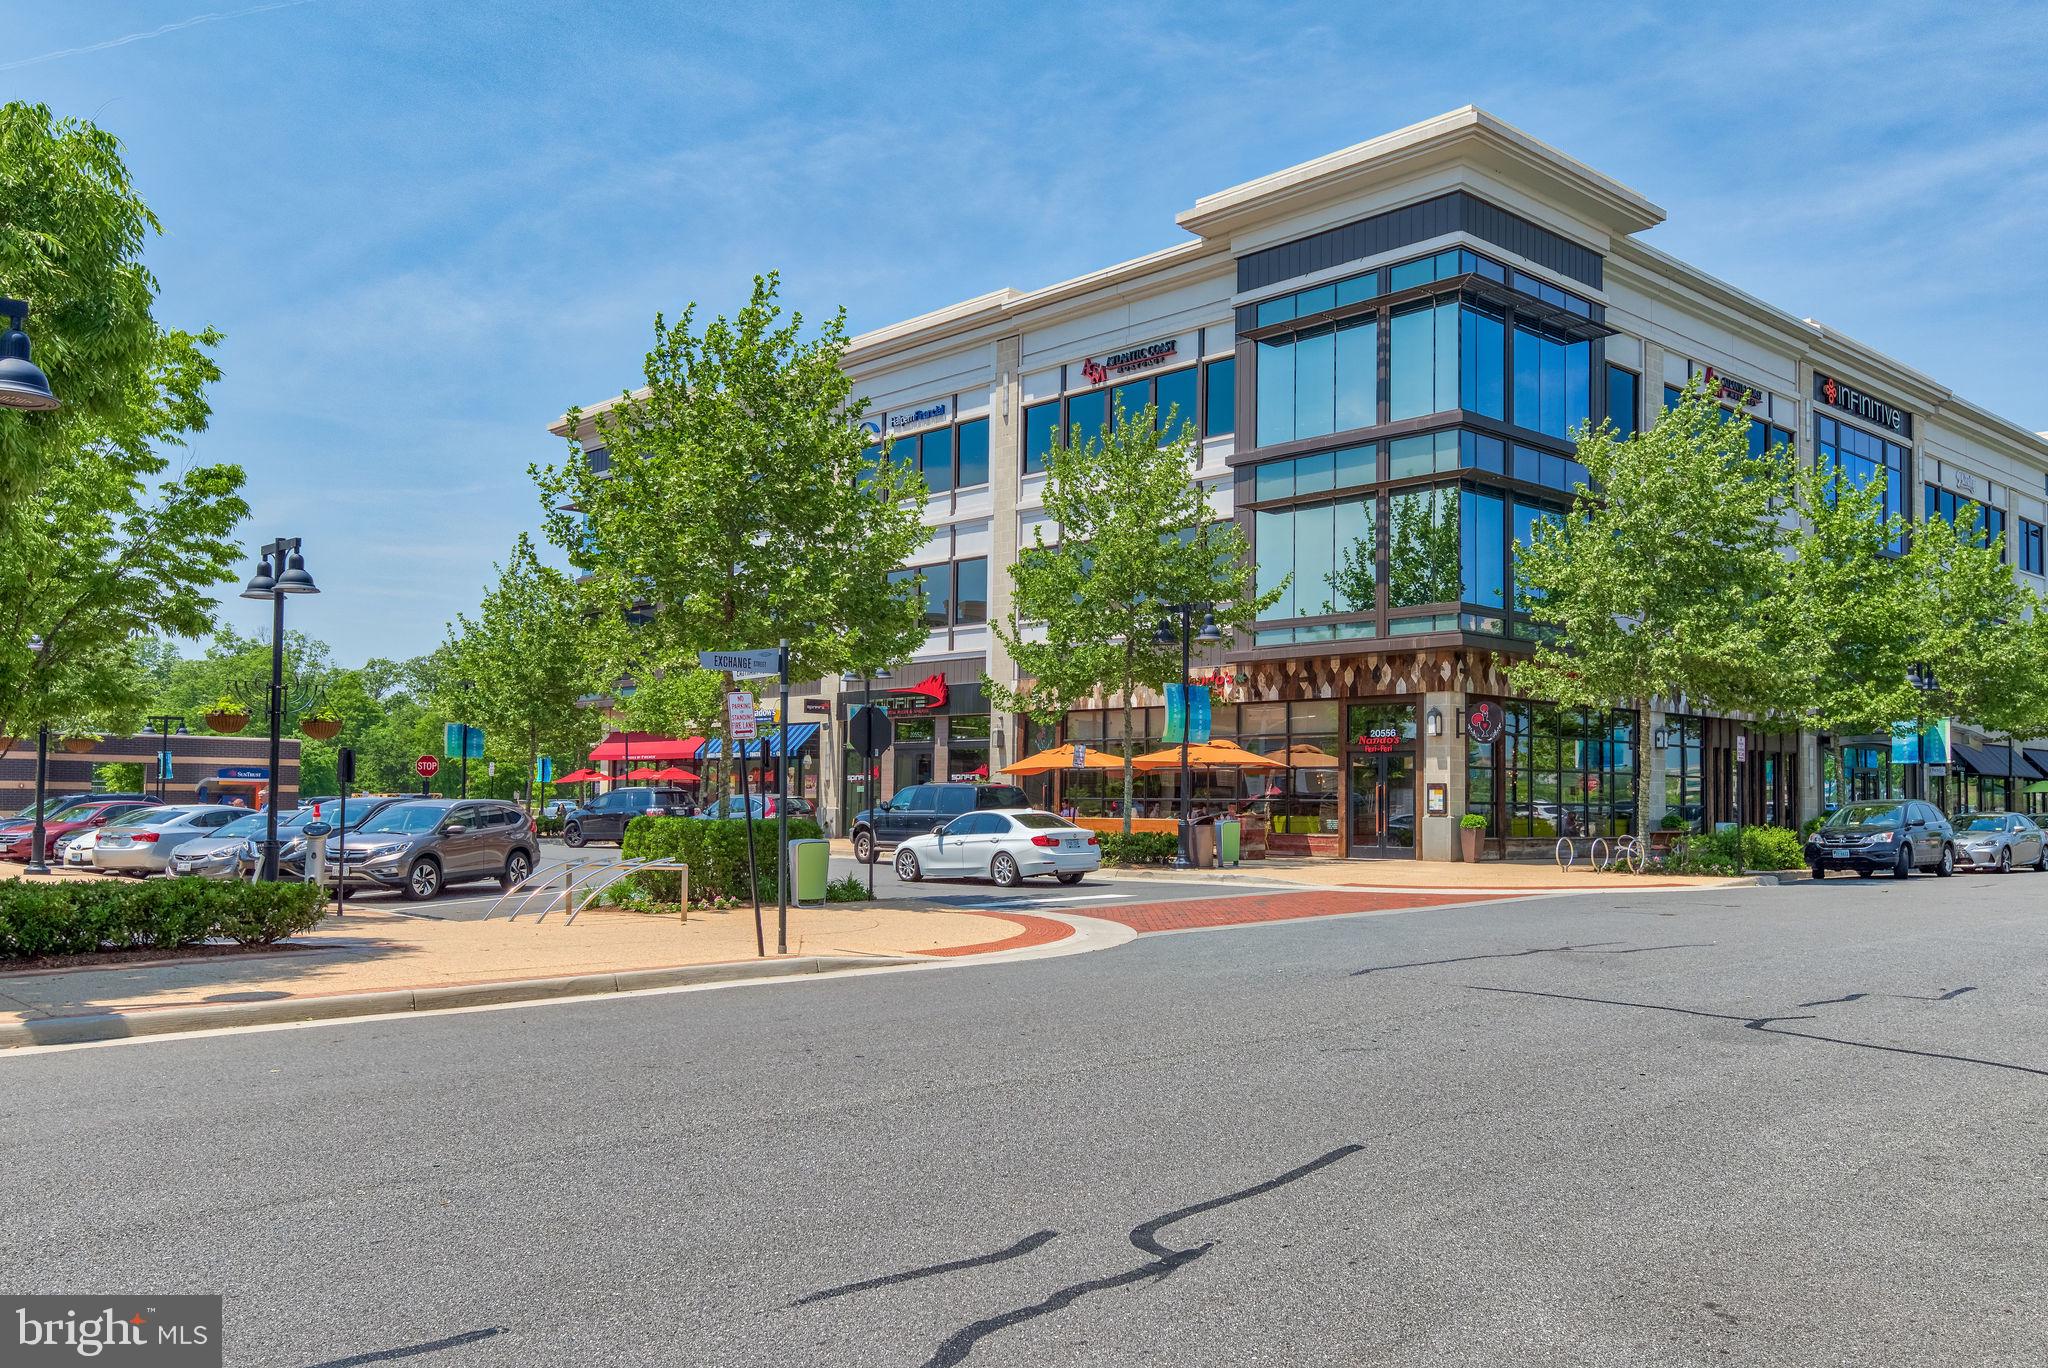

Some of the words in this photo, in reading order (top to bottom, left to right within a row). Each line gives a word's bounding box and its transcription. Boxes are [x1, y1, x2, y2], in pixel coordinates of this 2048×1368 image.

[1106, 347, 1147, 367] ATLANTIC
[1147, 339, 1177, 356] COAST
[714, 655, 752, 669] EXCHANGE
[753, 660, 767, 668] STREET
[731, 722, 743, 730] FIRE
[743, 721, 754, 729] LANE
[1370, 729, 1397, 738] 20556
[1359, 735, 1401, 746] Nando's
[1362, 744, 1393, 753] Peri-Peri
[417, 762, 437, 771] STOP
